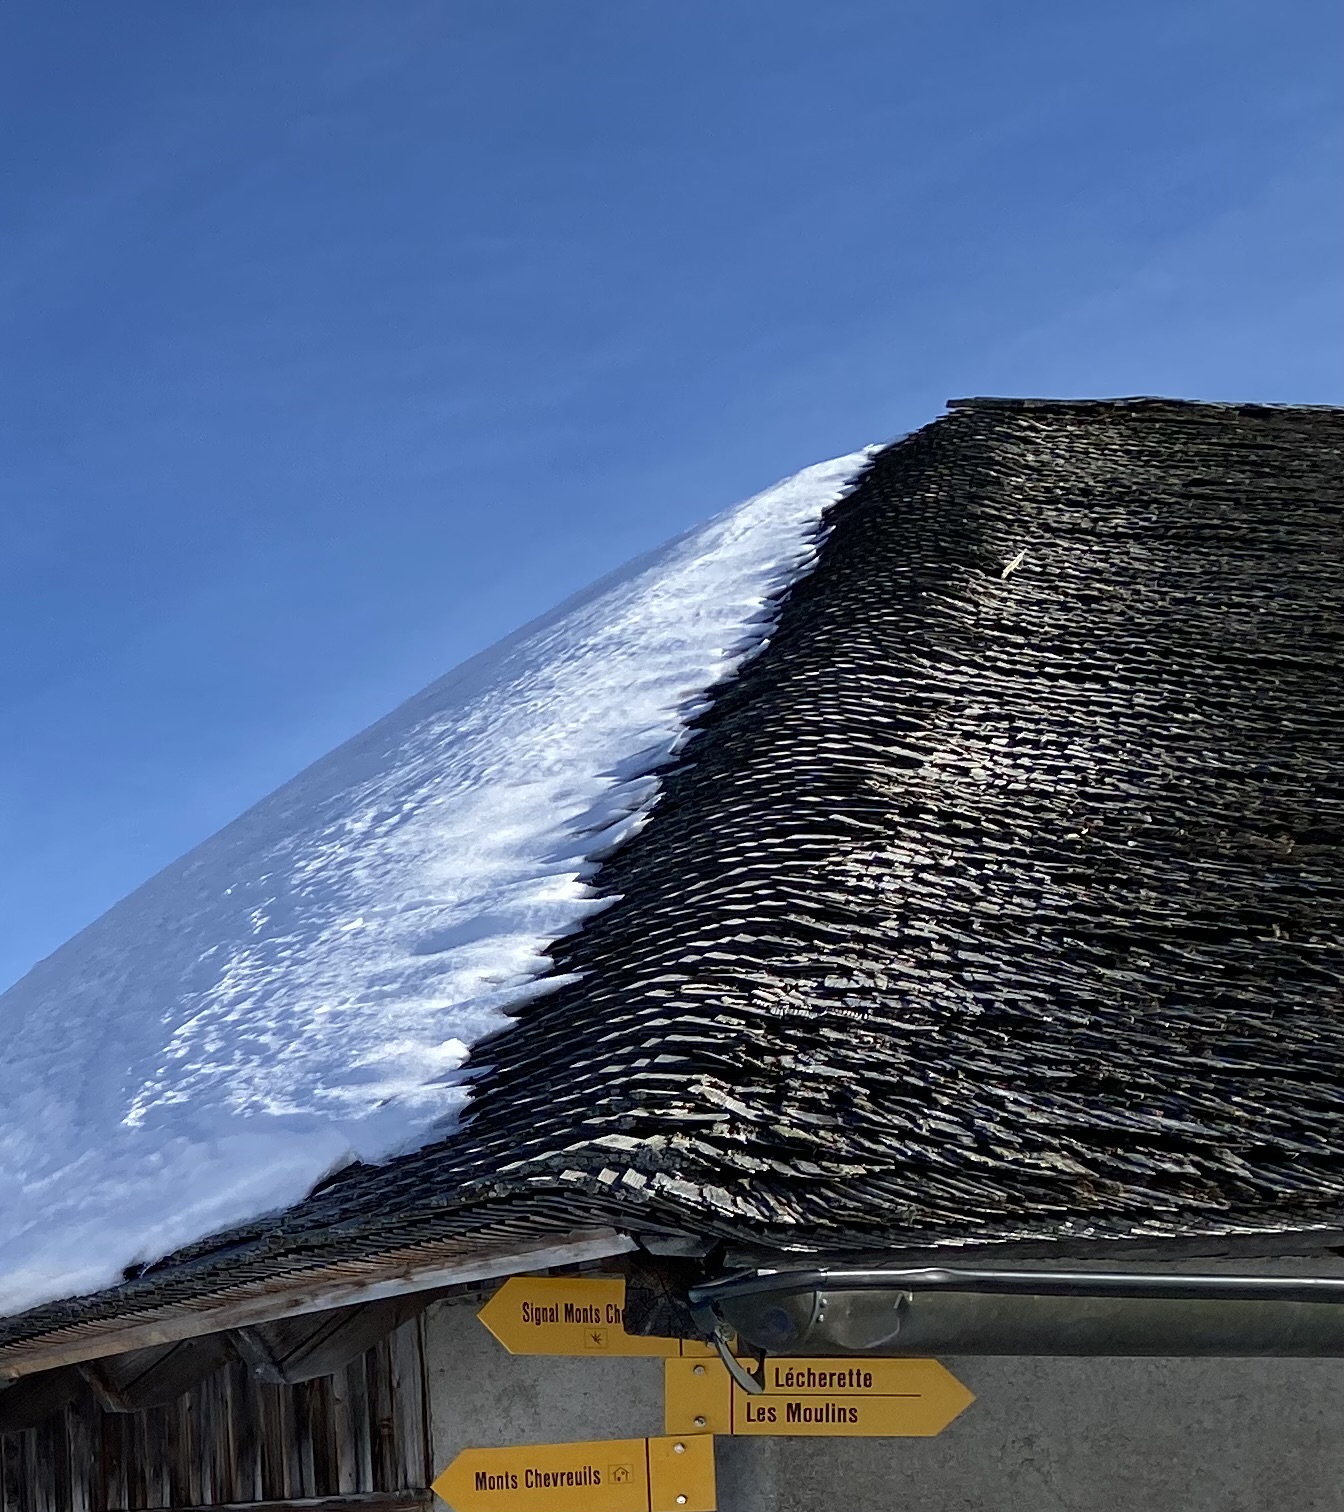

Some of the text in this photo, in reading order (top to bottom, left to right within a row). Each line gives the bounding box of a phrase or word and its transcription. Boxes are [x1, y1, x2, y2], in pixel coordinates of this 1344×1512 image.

[521, 1301, 560, 1326] Signal
[564, 1303, 601, 1324] Monts
[774, 1367, 873, 1388] Lécherette
[746, 1401, 858, 1423] Les Moulins
[474, 1465, 601, 1491] Monts Chevreuils
